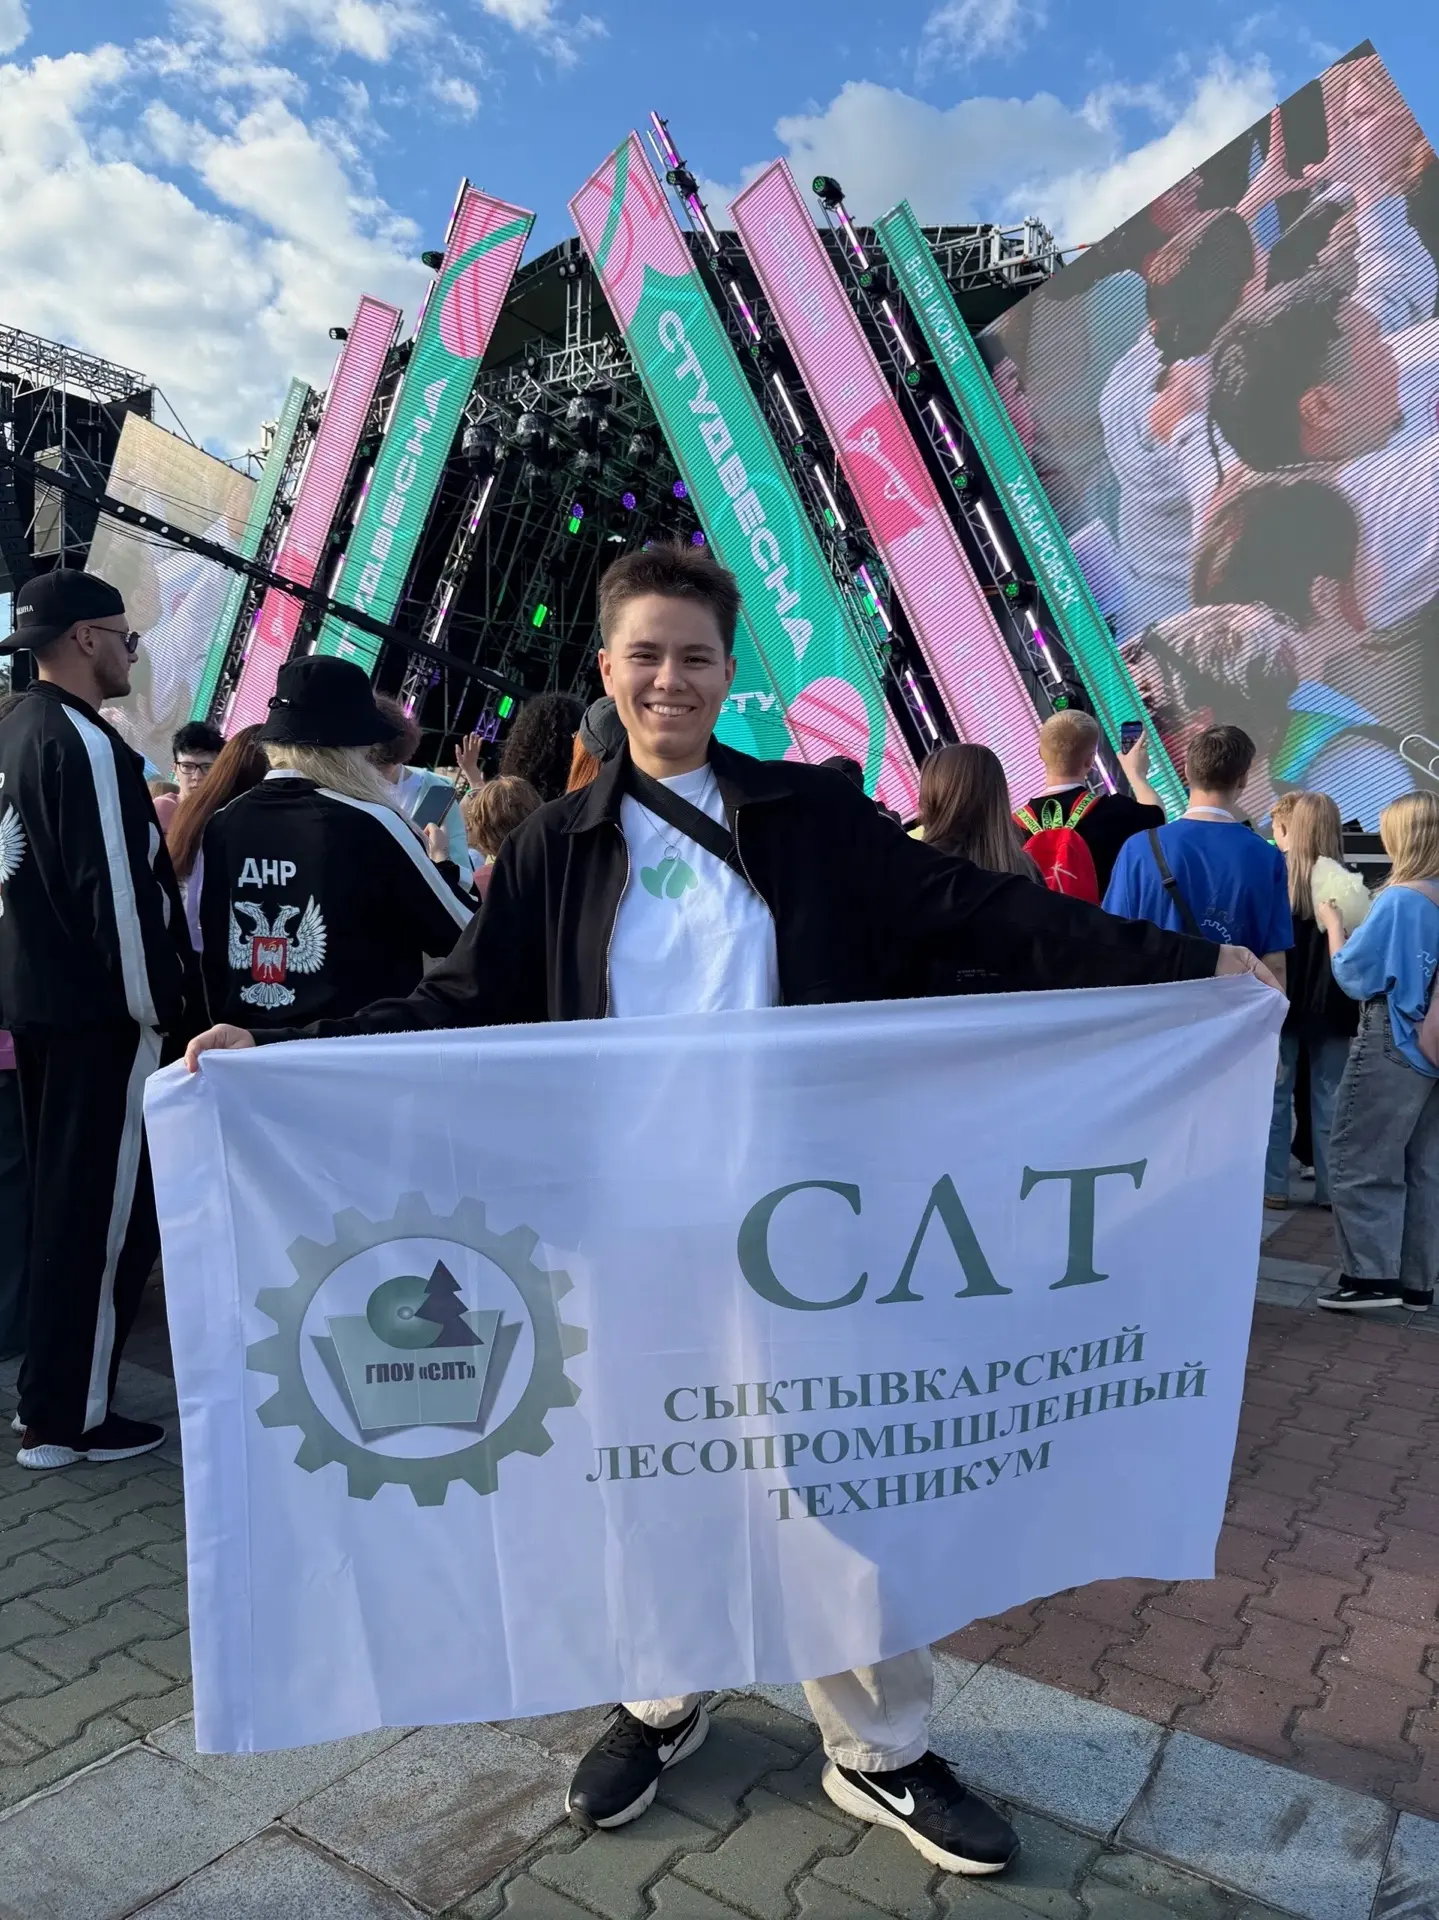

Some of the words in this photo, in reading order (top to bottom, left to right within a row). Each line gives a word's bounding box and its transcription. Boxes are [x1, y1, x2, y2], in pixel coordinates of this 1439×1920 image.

[335, 378, 449, 657] ТУДВЕСНА
[658, 310, 813, 661] СТУДВЕСНА
[1007, 475, 1080, 609] ХАБАРОВСК
[238, 857, 297, 888] ДНР
[737, 1158, 1147, 1311] СЛТ
[365, 1362, 414, 1385] ГПОУ
[418, 1361, 476, 1381] «СЛТ»
[586, 1360, 1210, 1482] ЛЕСОПРОМЫШЛЕННЫЙ
[664, 1324, 1148, 1422] СЫКТЫВКАРСКИЙ
[768, 1440, 1054, 1521] ТЕХНИКУМ
